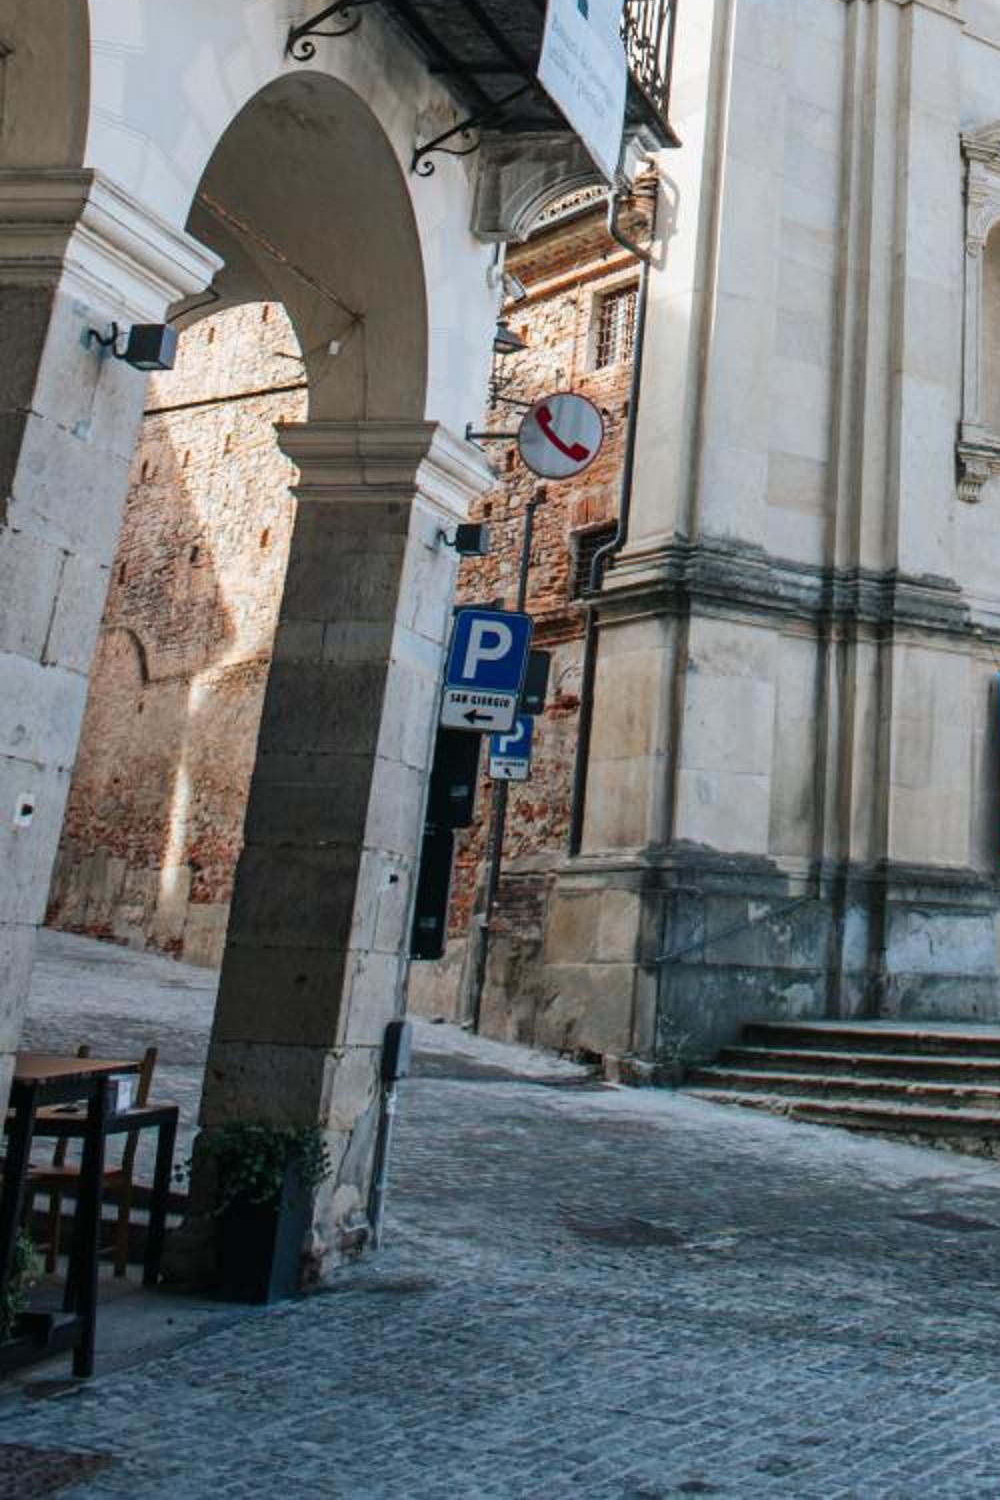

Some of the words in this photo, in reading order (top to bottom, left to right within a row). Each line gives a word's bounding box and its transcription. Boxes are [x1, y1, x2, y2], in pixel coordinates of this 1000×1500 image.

[462, 619, 512, 679] P
[450, 693, 468, 704] SAN
[471, 695, 510, 708] GIORGIO
